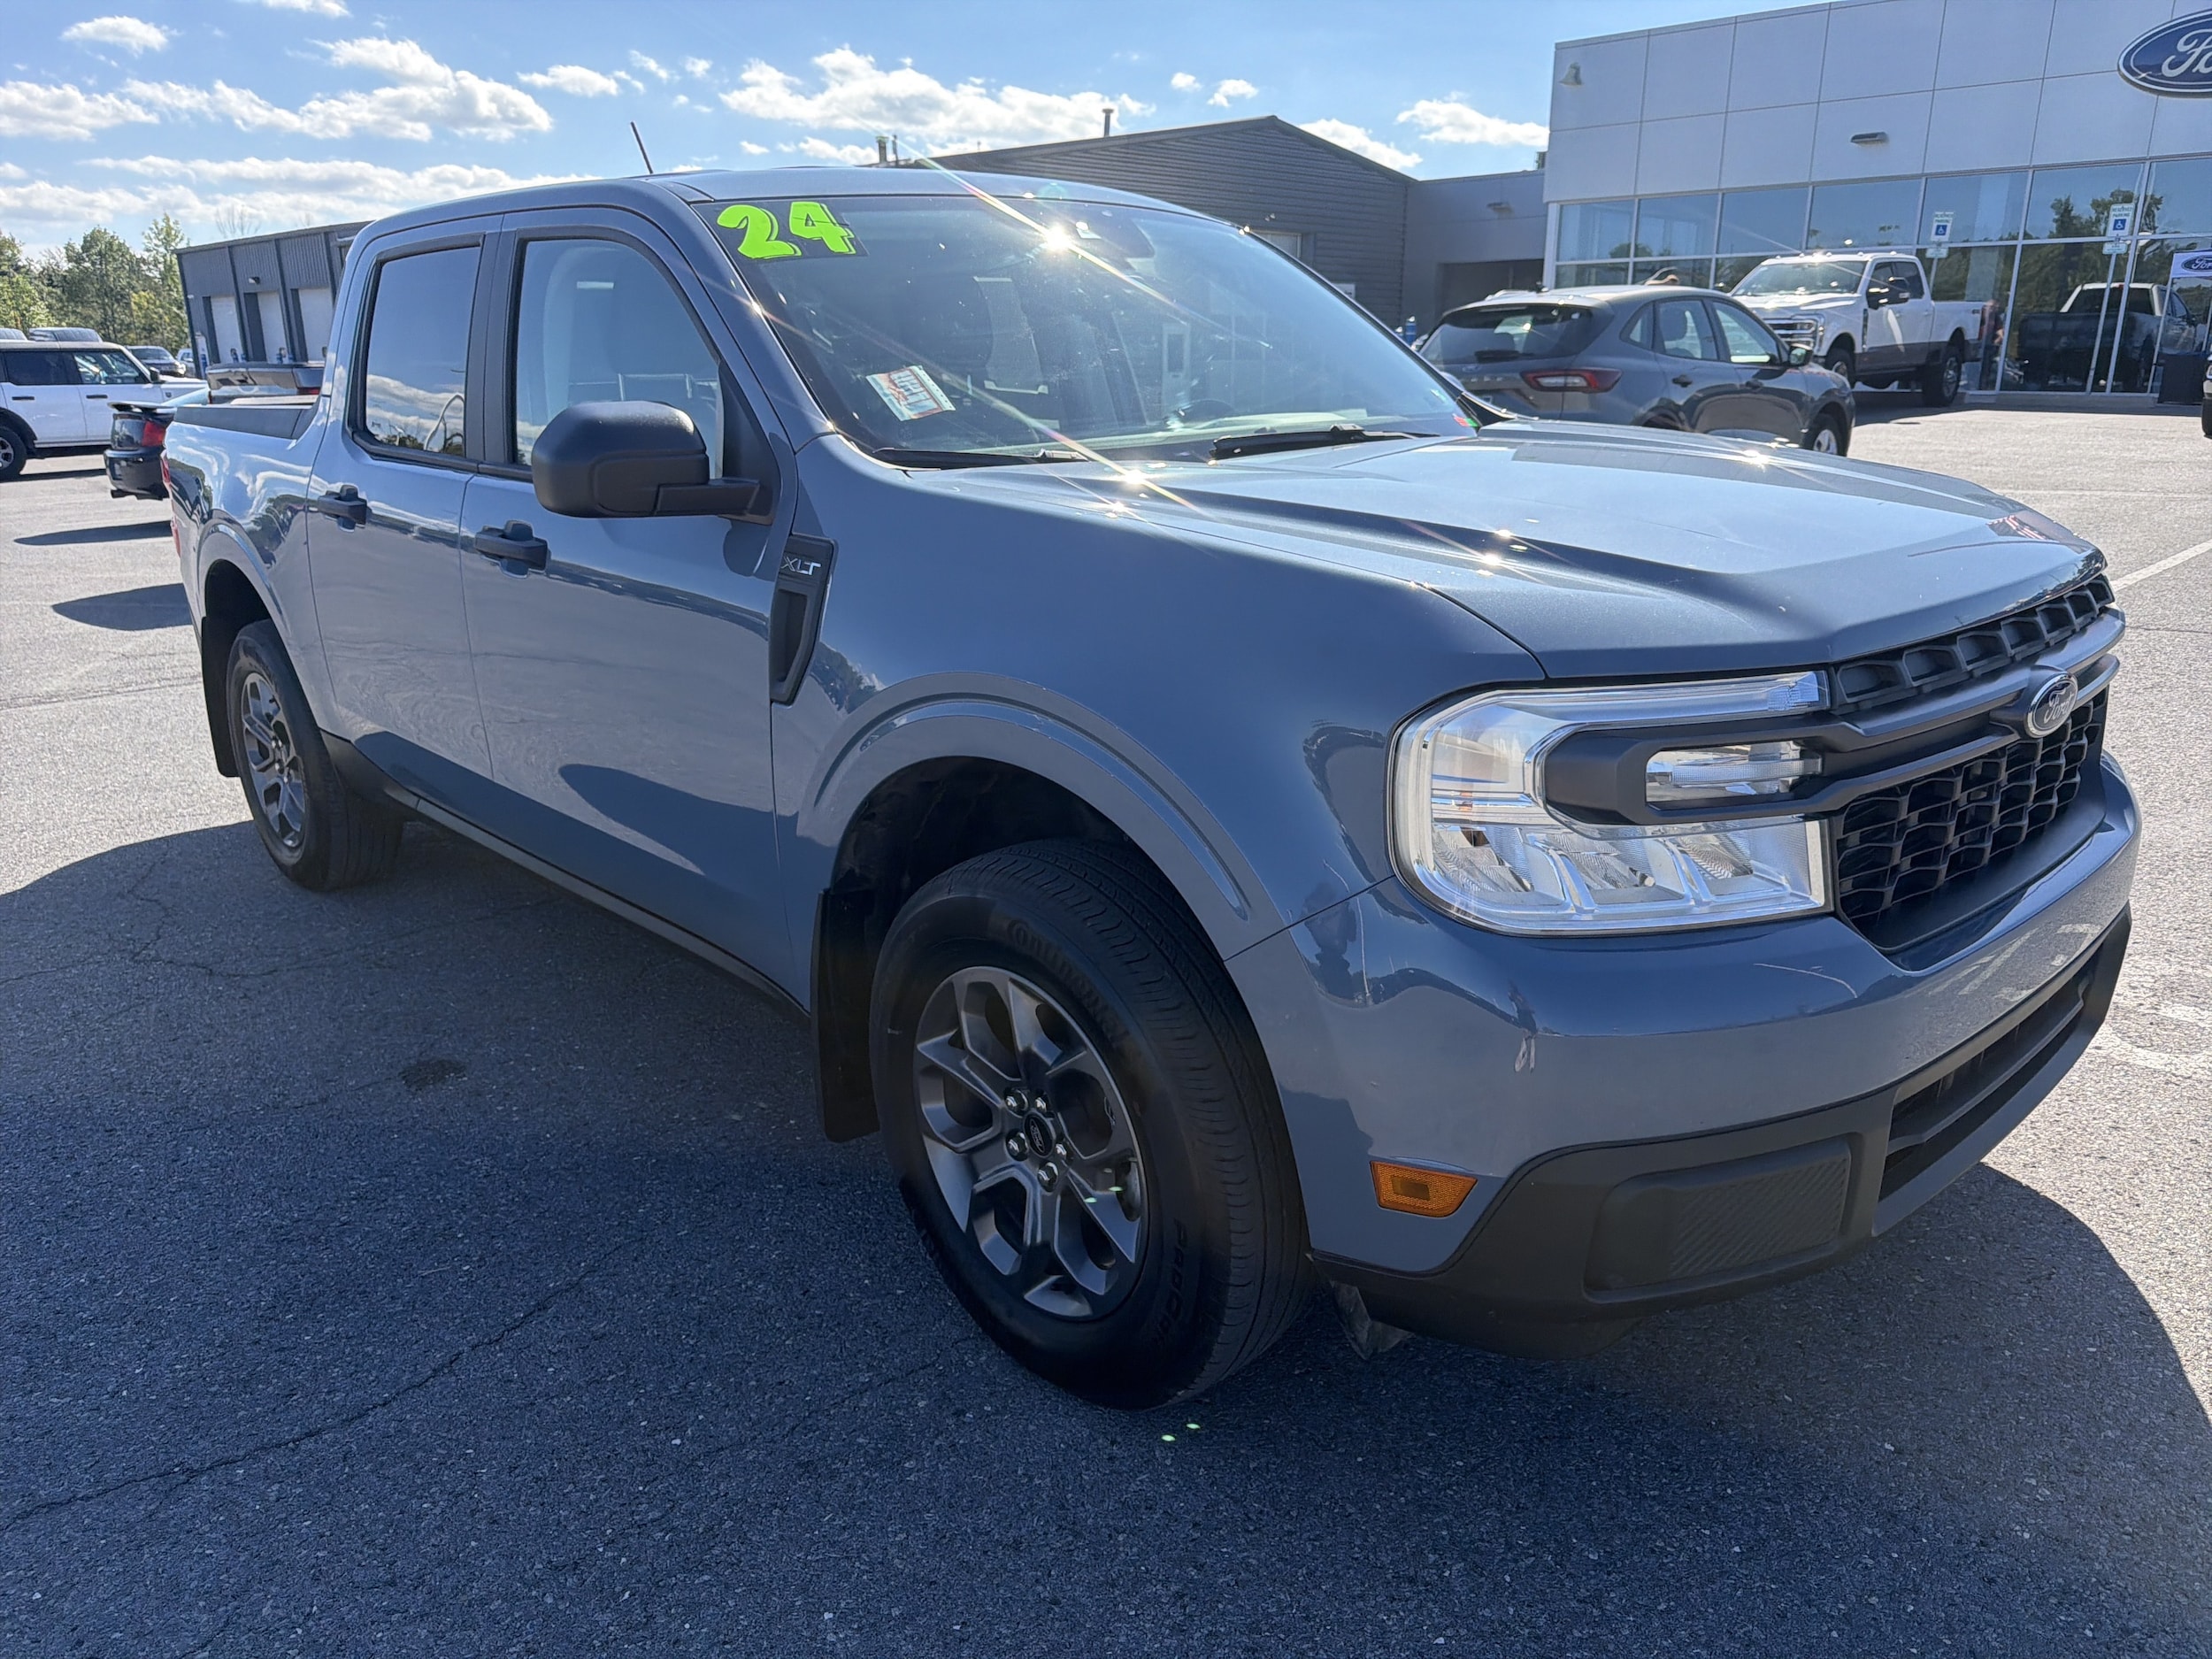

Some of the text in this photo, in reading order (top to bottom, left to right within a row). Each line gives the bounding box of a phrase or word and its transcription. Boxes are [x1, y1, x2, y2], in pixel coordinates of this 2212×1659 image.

[717, 201, 856, 259] 24
[780, 556, 822, 576] XLT
[2043, 687, 2075, 725] Ford
